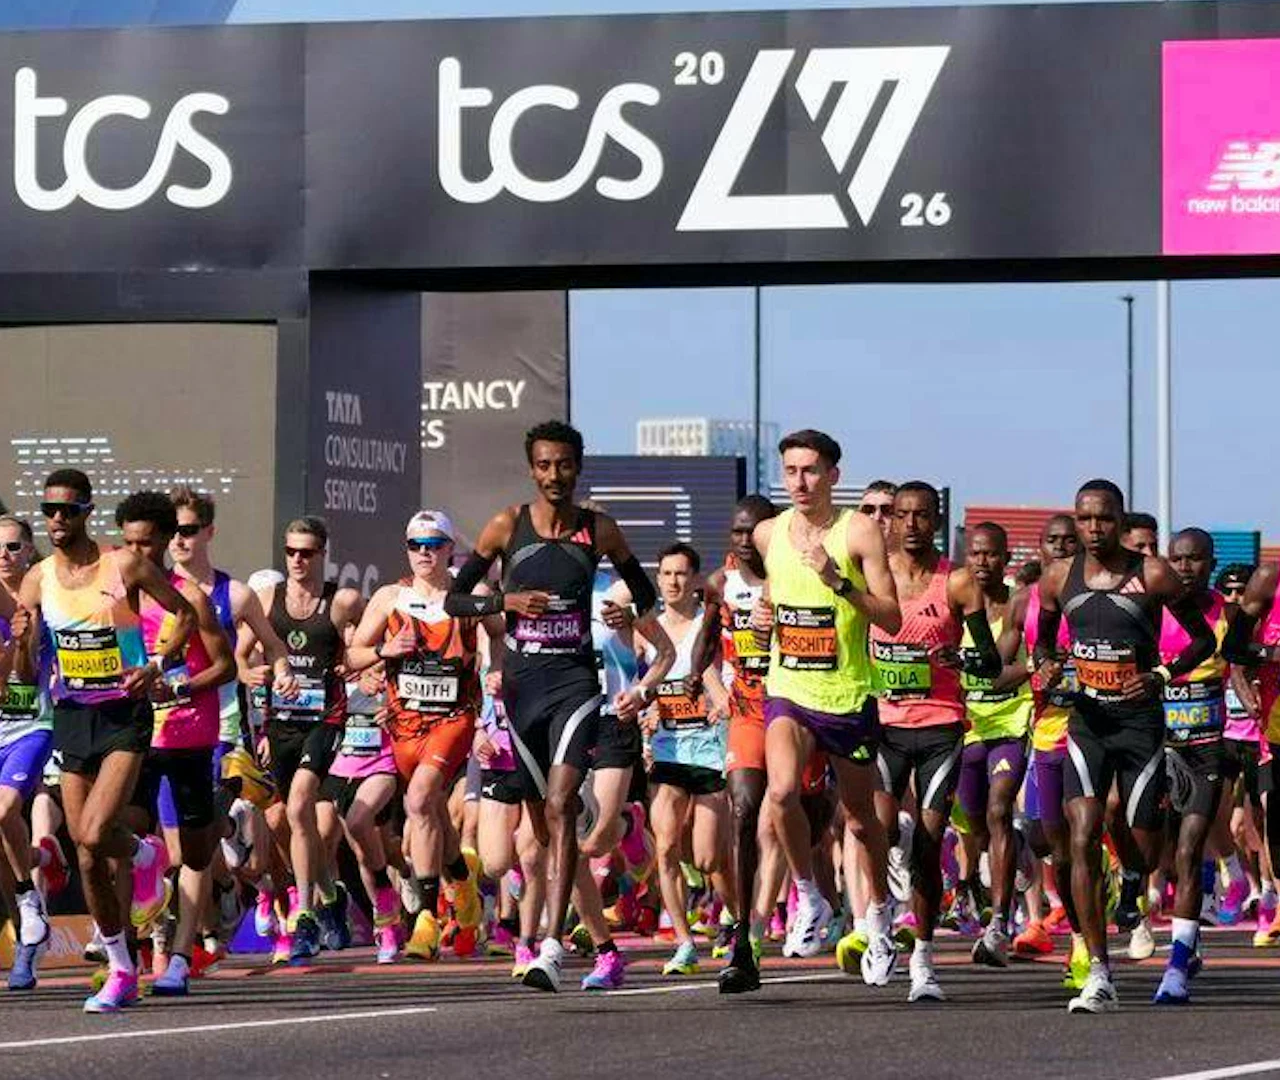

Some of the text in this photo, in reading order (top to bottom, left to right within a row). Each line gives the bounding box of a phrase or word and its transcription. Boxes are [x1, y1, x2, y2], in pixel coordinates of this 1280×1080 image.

[439, 51, 724, 203] tcs 20
[15, 67, 232, 211] tcs
[900, 192, 951, 226] 26
[1188, 198, 1227, 212] new
[325, 392, 363, 425] TATA
[324, 434, 407, 475] CONSULTANCY
[324, 479, 377, 514] SERVICES
[778, 606, 797, 625] tcs
[518, 619, 580, 639] KEJELCHA
[56, 632, 80, 649] tcs
[874, 640, 892, 661] tcs
[1073, 641, 1096, 659] tcs
[288, 655, 316, 668] RMY
[879, 668, 918, 685] TOLA
[404, 682, 450, 697] SMITH
[1165, 686, 1189, 700] tcs
[1167, 706, 1210, 727] PACE
